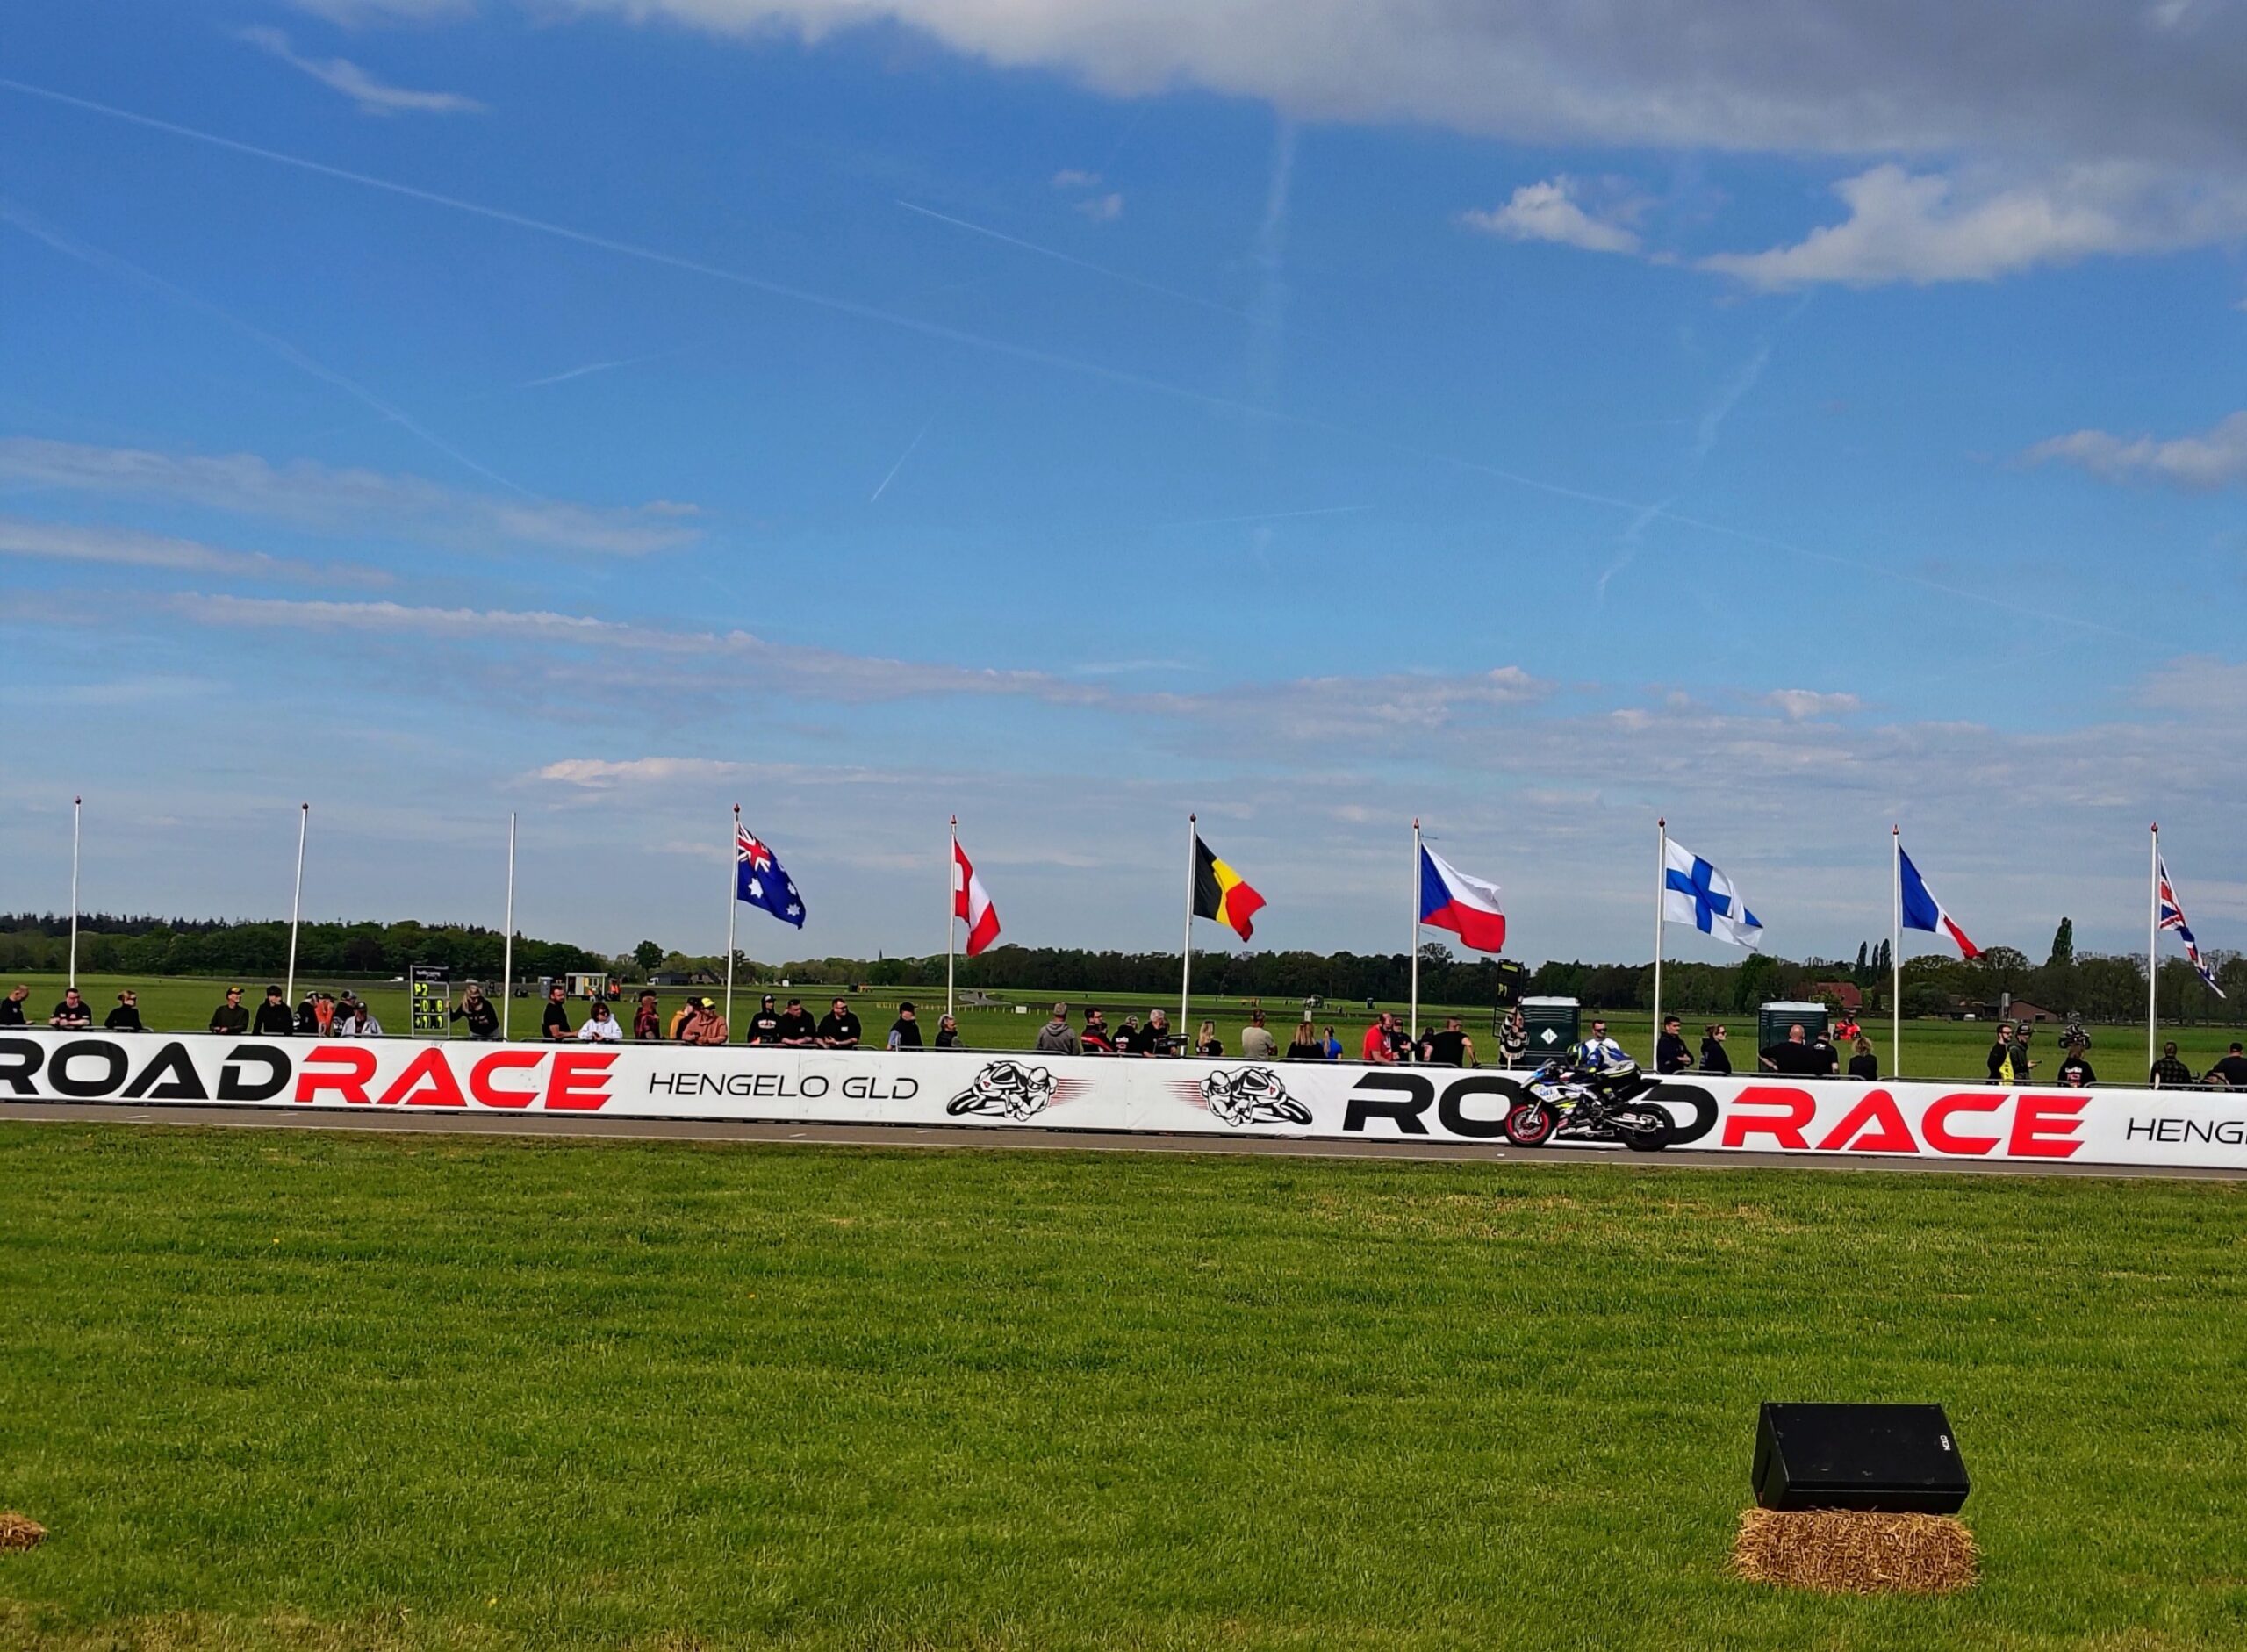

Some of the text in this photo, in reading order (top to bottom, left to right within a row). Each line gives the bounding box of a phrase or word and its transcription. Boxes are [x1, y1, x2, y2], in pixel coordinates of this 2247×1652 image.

[413, 982, 428, 996] P2
[649, 1072, 919, 1100] HENGELO GLD
[1343, 1072, 2093, 1158] RODRACE
[2126, 1117, 2247, 1145] HENG
